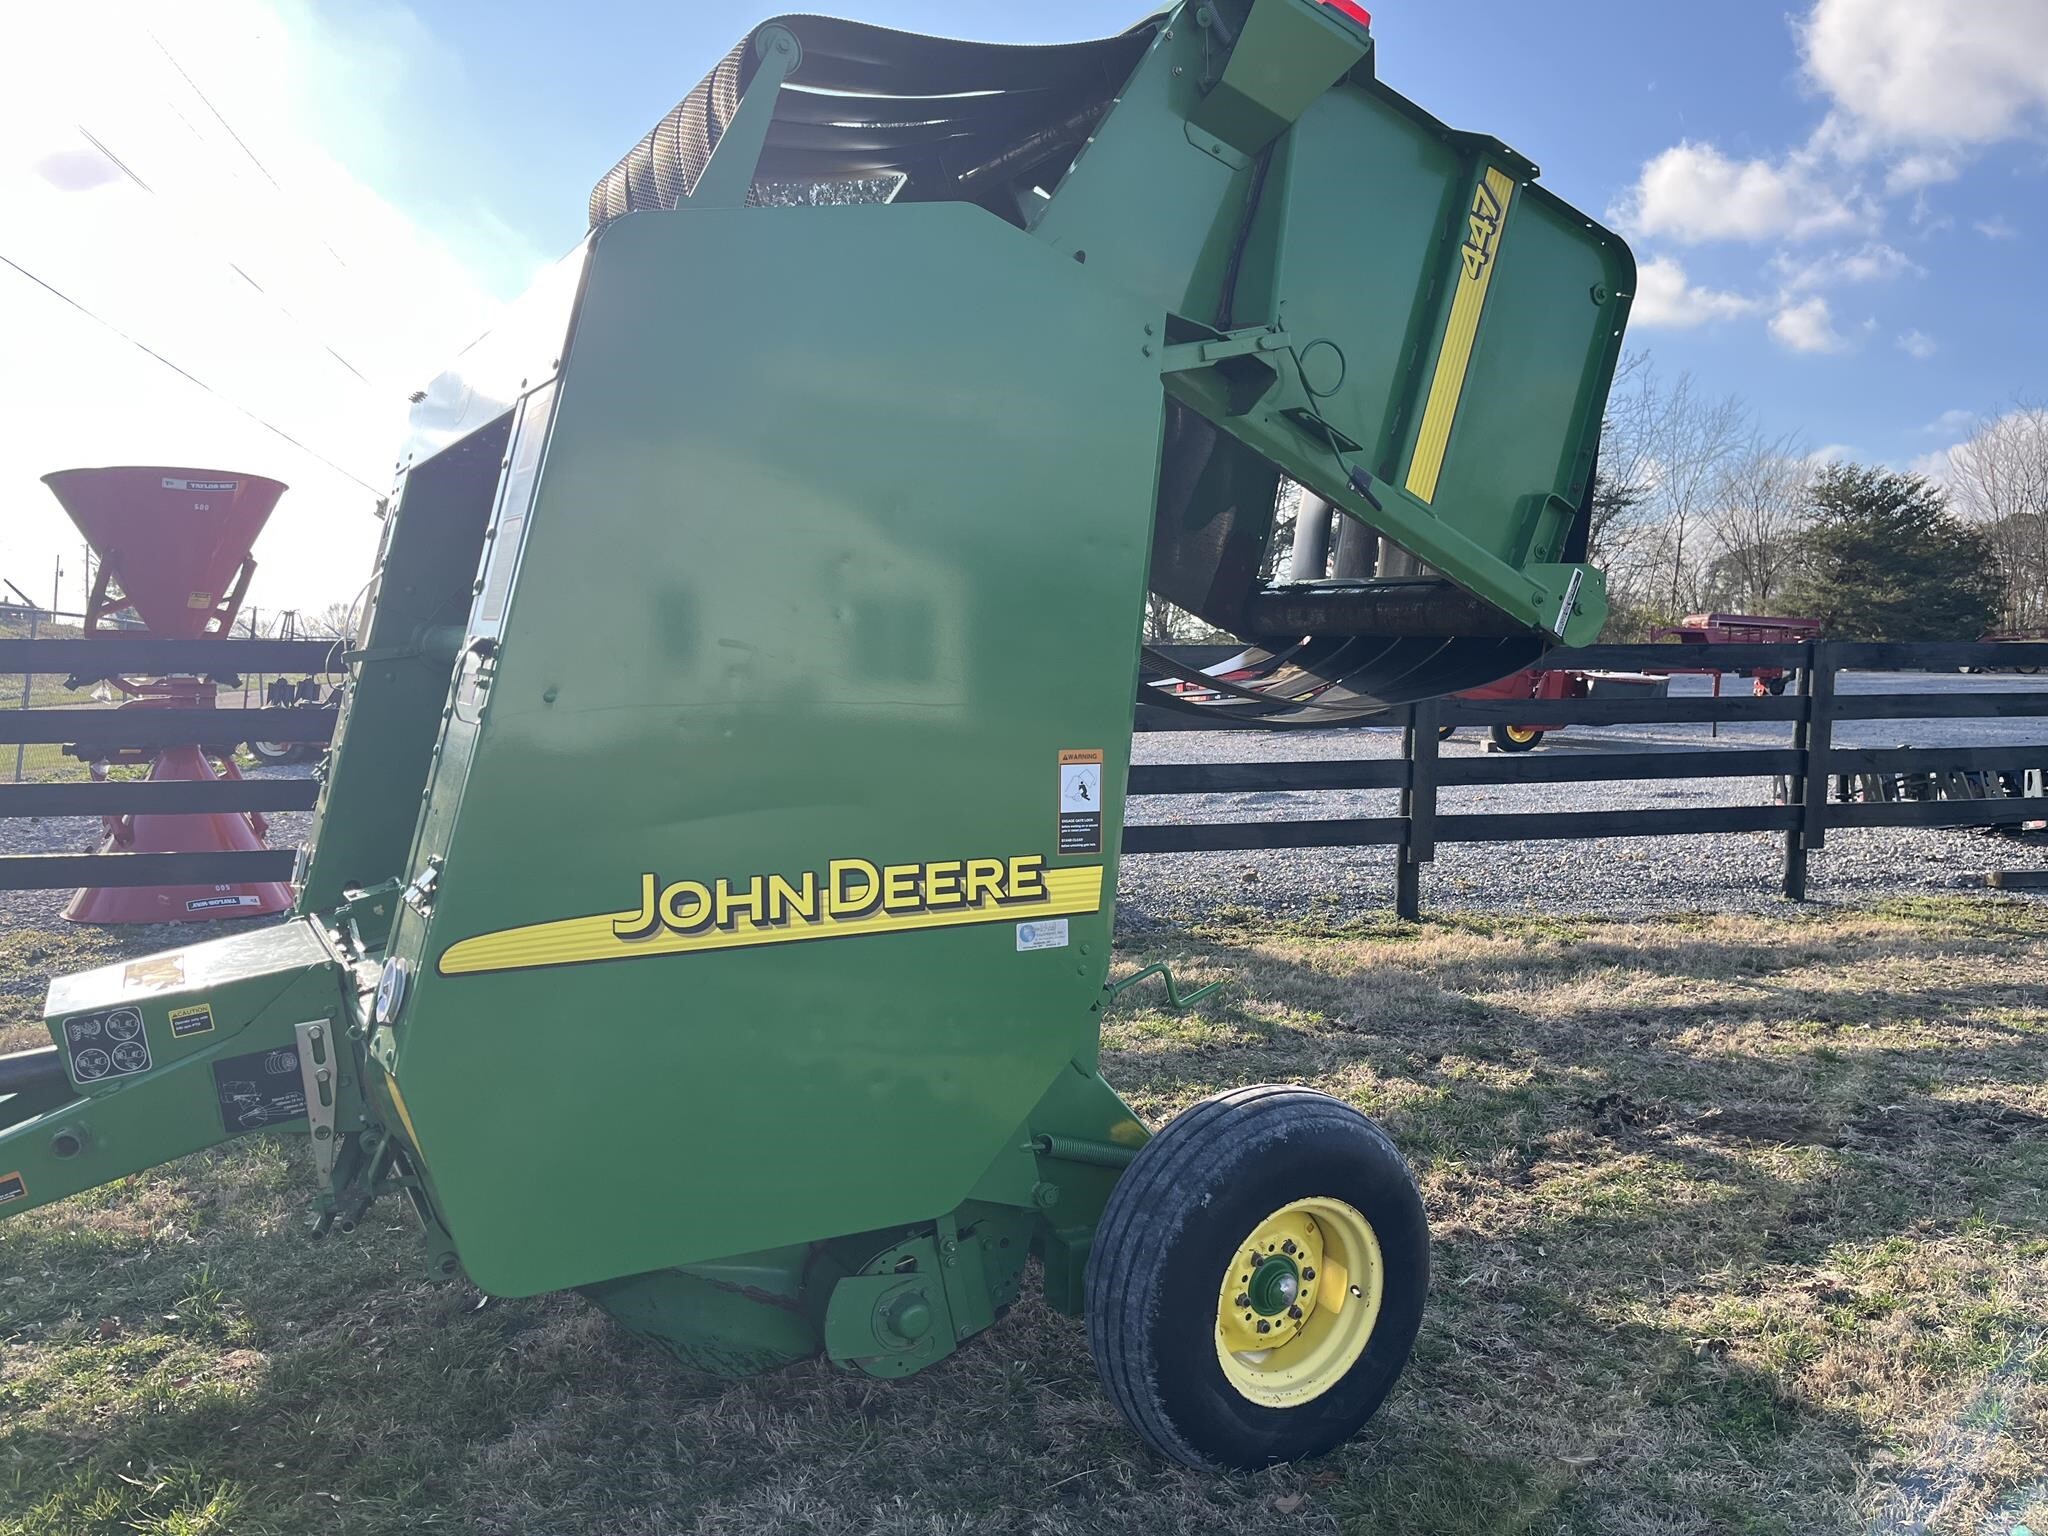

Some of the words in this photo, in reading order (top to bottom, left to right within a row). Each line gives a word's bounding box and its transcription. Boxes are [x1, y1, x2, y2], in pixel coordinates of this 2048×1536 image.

[1460, 181, 1501, 280] 447
[613, 872, 820, 940] JOHN
[829, 853, 1047, 920] DEERE
[176, 1005, 209, 1016] CAUTION
